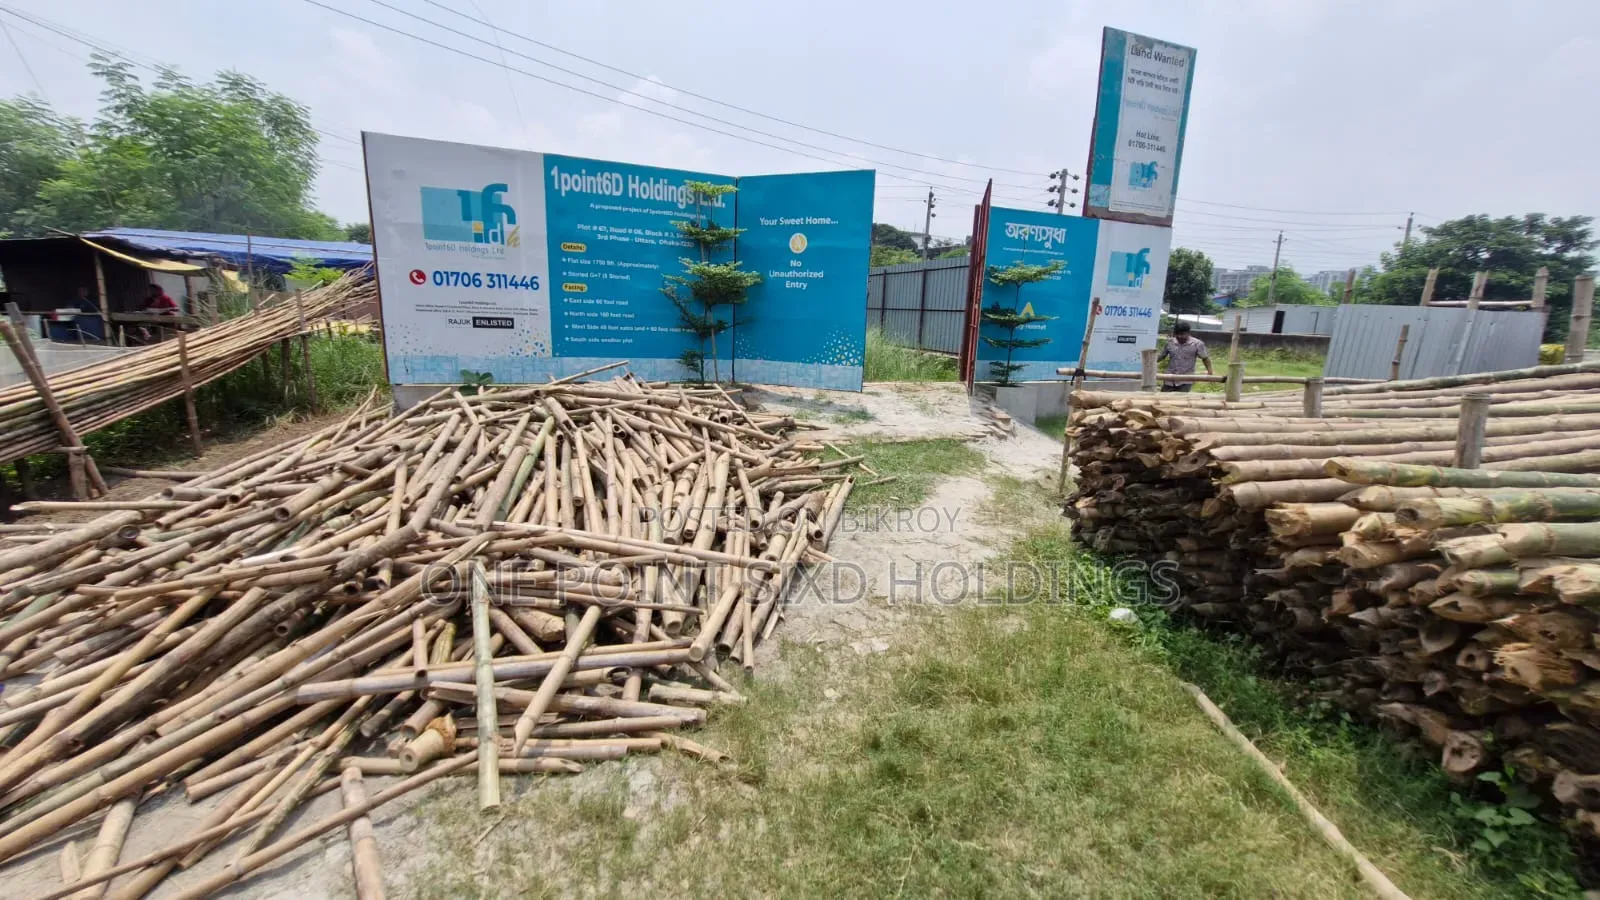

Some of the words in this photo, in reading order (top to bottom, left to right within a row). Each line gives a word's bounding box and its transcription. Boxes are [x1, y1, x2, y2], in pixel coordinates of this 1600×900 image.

[1130, 44, 1152, 59] Land
[1154, 50, 1184, 67] Wanted
[1136, 130, 1146, 138] Hot
[551, 165, 623, 197] 1point6D
[628, 174, 695, 209] Holdings
[595, 204, 622, 212] proposed
[622, 206, 642, 214] project
[760, 217, 777, 226] Your
[779, 217, 804, 225] Sweet
[805, 216, 838, 225] Home...
[1005, 222, 1067, 249] অরণ্যসুধা
[769, 270, 824, 278] Unauthorized
[432, 270, 482, 288] 01706
[486, 273, 539, 290] 311446
[785, 281, 808, 290] Entry
[1104, 305, 1127, 316] 01706
[1129, 306, 1152, 318] 311446
[475, 318, 513, 327] ENLISTED
